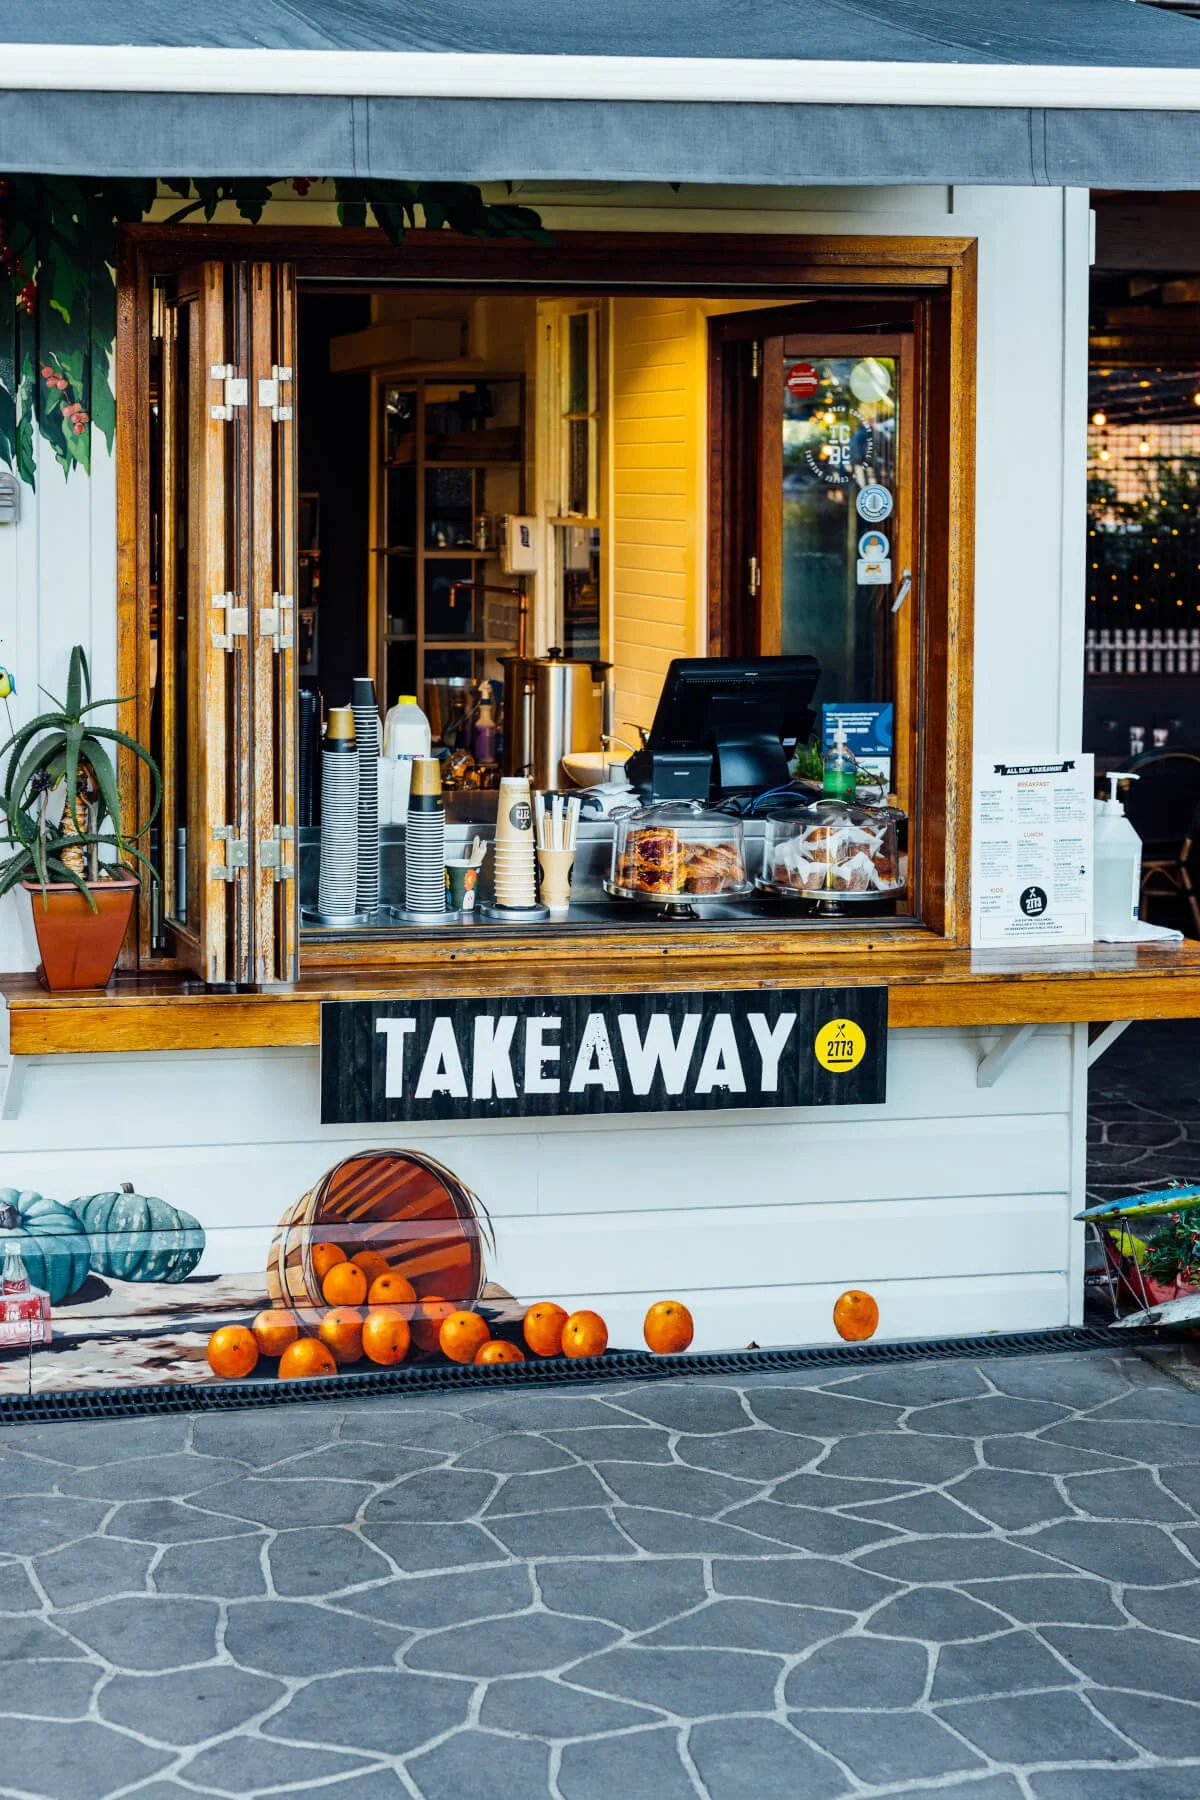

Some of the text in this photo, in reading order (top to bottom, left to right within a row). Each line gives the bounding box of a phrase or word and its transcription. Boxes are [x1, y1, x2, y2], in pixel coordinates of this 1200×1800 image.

[1031, 765, 1063, 773] TAKEAWAY
[1026, 897, 1042, 909] 2773
[827, 1040, 854, 1057] 2773
[375, 1012, 798, 1100] TAKEAWAY
